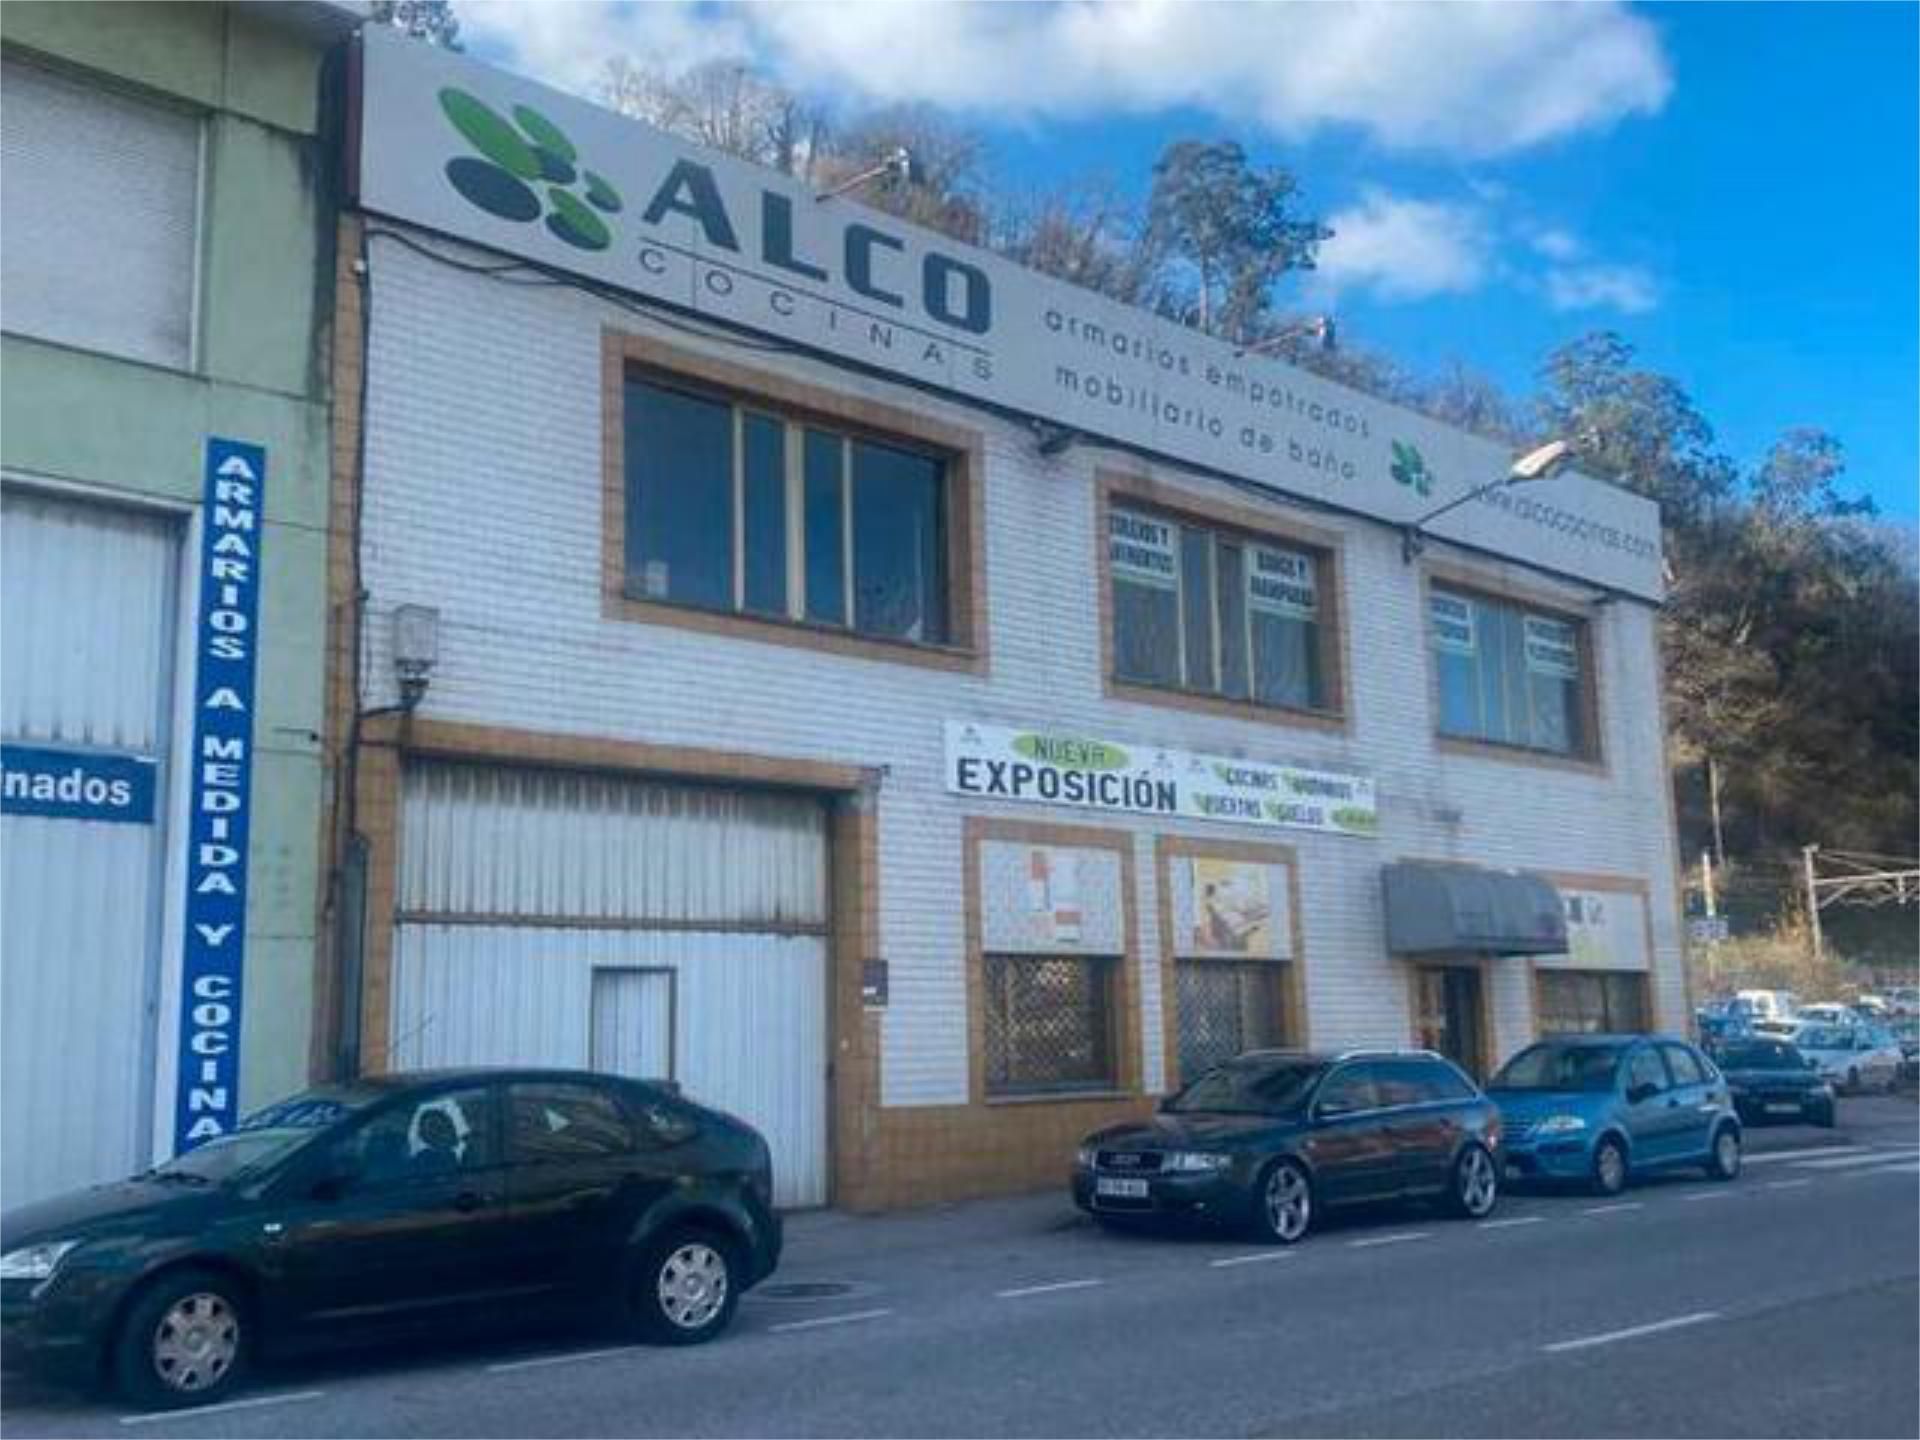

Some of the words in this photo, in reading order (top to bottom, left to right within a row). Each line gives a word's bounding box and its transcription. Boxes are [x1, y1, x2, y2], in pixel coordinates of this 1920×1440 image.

[642, 157, 992, 335] ALCO
[640, 247, 993, 381] COCINAS
[1045, 310, 1190, 375] armarios
[1205, 363, 1370, 437] empotrados
[1055, 364, 1225, 437] mobiliario
[1240, 424, 1273, 453] de
[209, 455, 255, 659] ARMARIOS
[205, 686, 245, 710] A
[0, 762, 132, 807] nados
[957, 757, 1178, 812] EXPOSICIÓN
[1034, 736, 1106, 769] NUEVA
[197, 738, 244, 895] MEDIDA
[194, 922, 236, 947] Y
[186, 974, 233, 1139] COCINA
